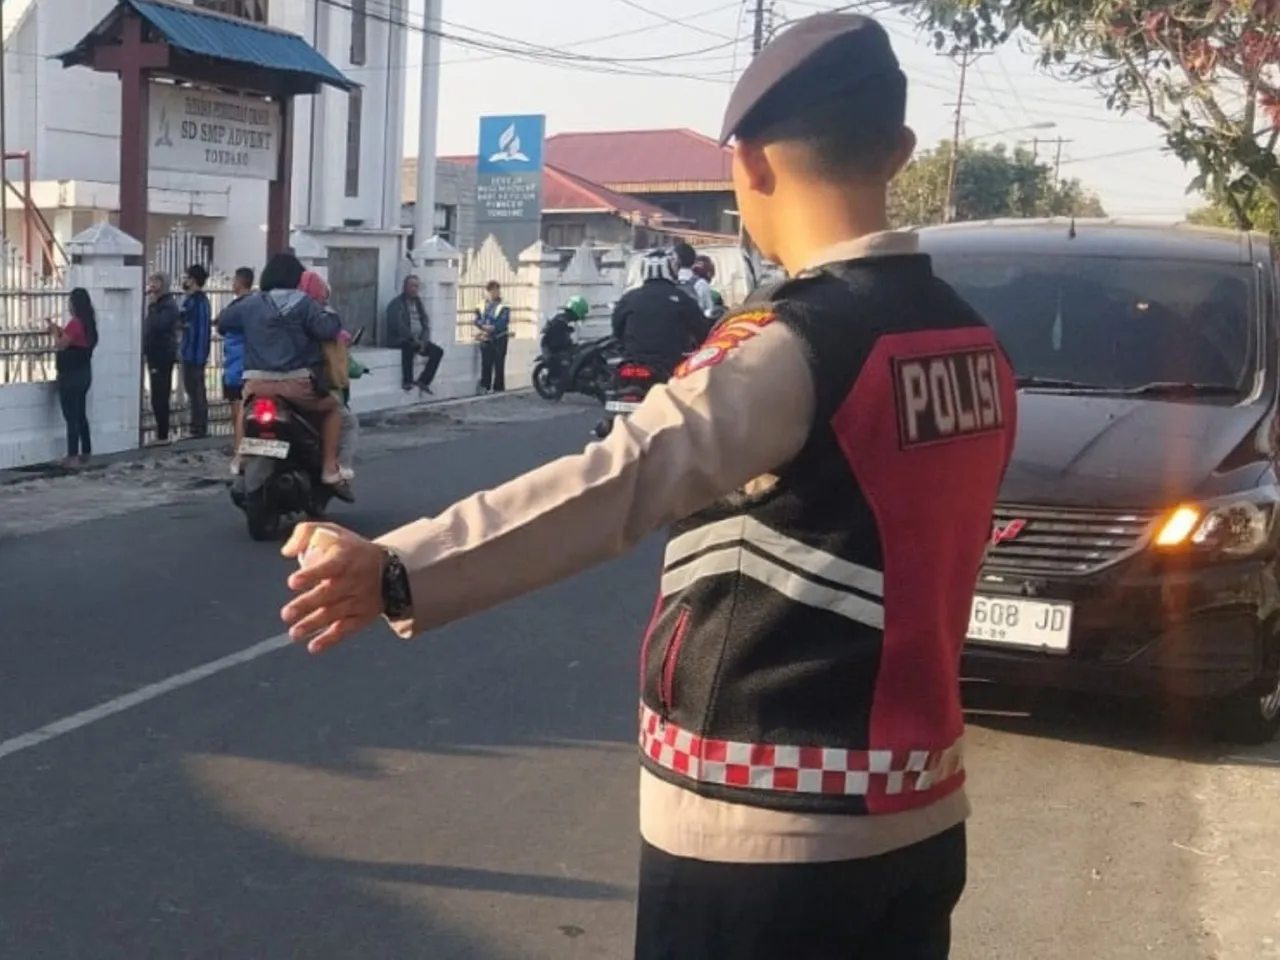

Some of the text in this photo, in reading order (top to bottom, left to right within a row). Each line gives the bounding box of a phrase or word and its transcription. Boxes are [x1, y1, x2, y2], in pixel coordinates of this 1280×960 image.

[181, 120, 272, 150] SD SMP ADVENT
[901, 352, 1002, 441] POLISI
[1035, 608, 1065, 632] JD
